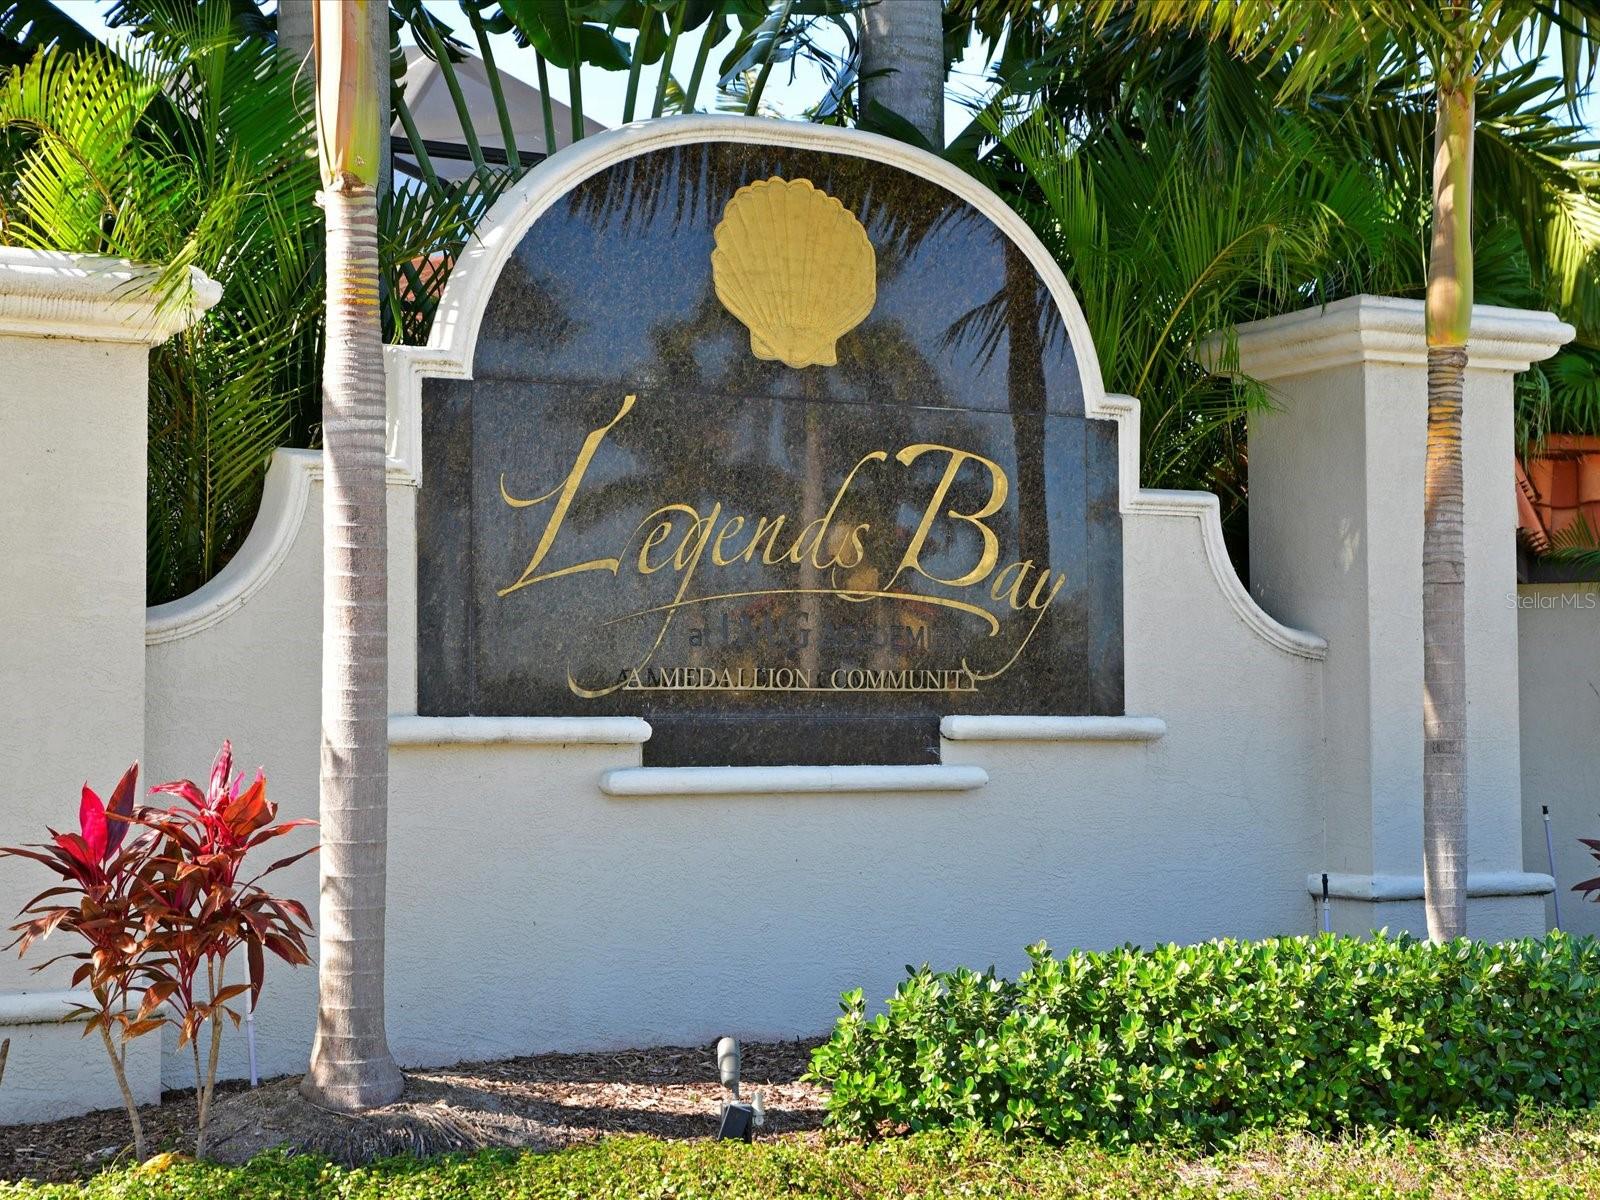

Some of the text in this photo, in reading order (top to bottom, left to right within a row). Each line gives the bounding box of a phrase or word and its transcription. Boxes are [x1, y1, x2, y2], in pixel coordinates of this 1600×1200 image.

[498, 394, 1066, 699] Legends Bay
[625, 667, 982, 691] A MEDALLION COMMUNITY
